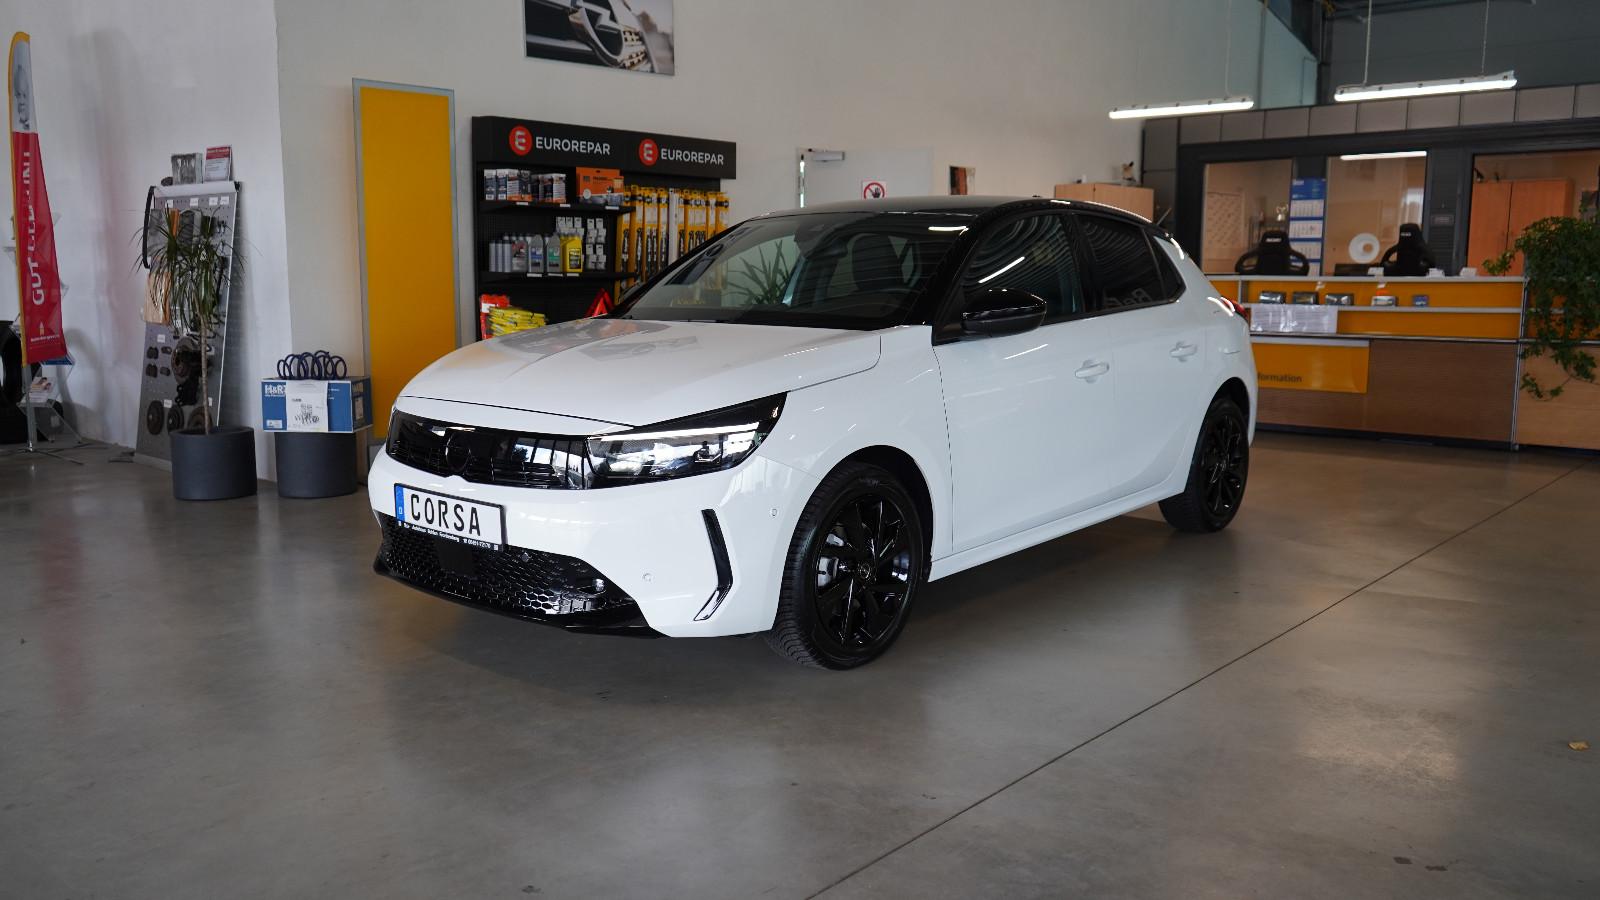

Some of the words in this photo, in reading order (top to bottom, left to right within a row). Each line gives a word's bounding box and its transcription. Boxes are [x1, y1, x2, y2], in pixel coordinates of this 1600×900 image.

[535, 136, 611, 156] EUROREPAR
[660, 147, 724, 166] EUROREPAR
[27, 257, 45, 306] GUT
[410, 493, 481, 536] CORSA
